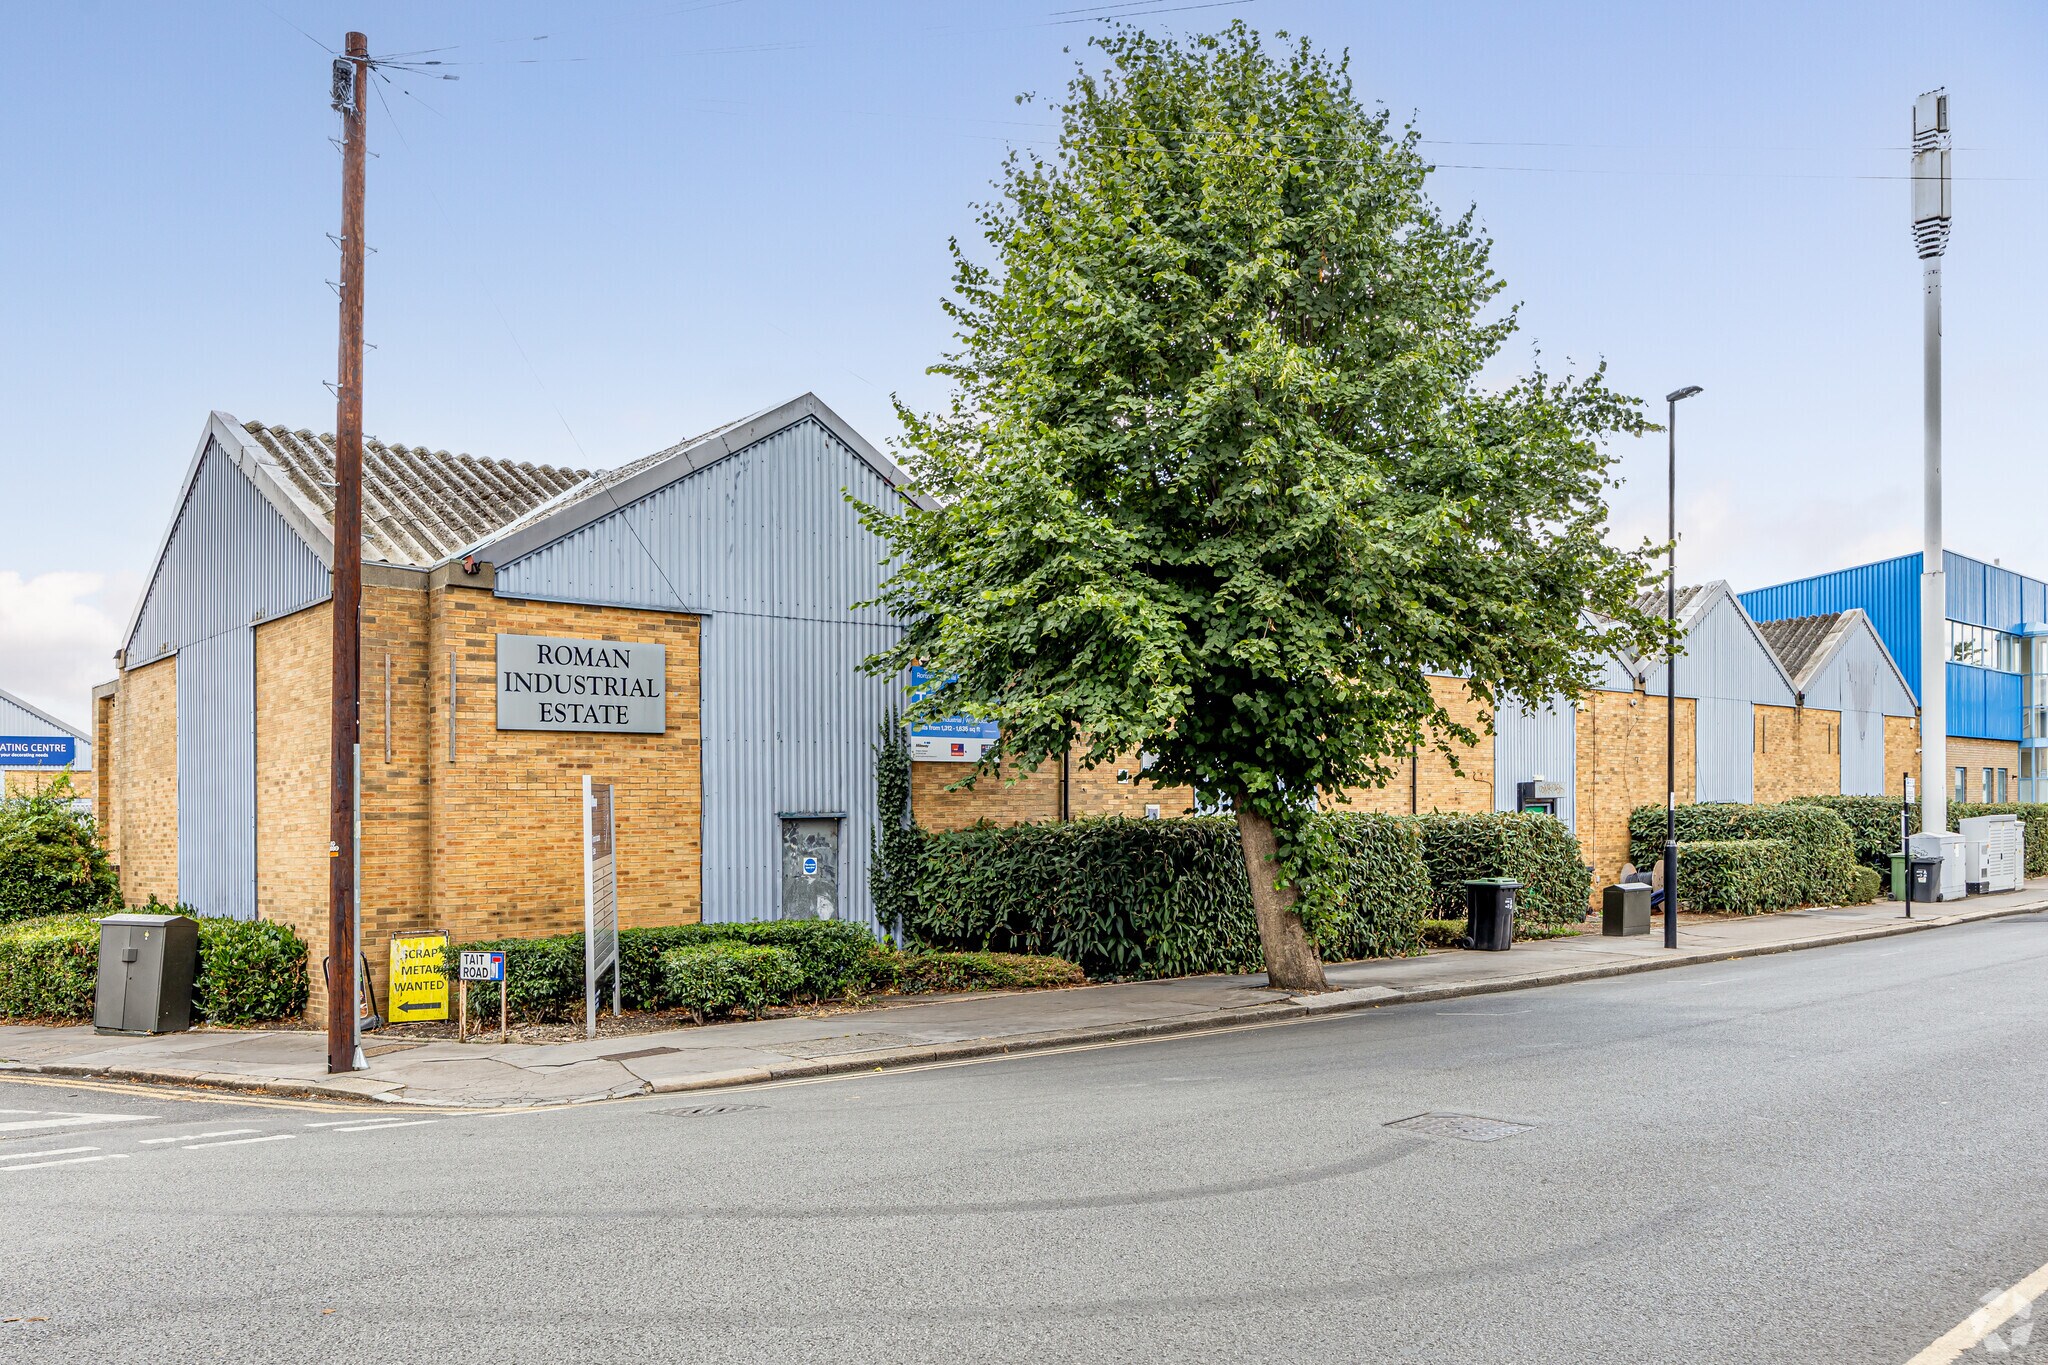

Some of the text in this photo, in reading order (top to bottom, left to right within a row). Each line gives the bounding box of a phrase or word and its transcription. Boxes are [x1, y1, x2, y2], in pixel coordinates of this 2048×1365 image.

[537, 644, 631, 669] ROMAN
[503, 671, 660, 698] INDUSTRIAL
[539, 702, 630, 725] ESTATE
[31, 744, 67, 752] CENTRE
[404, 948, 438, 959] SCRAP
[463, 954, 485, 965] TAIT
[463, 967, 489, 978] ROAD
[394, 980, 445, 992] WANTED
